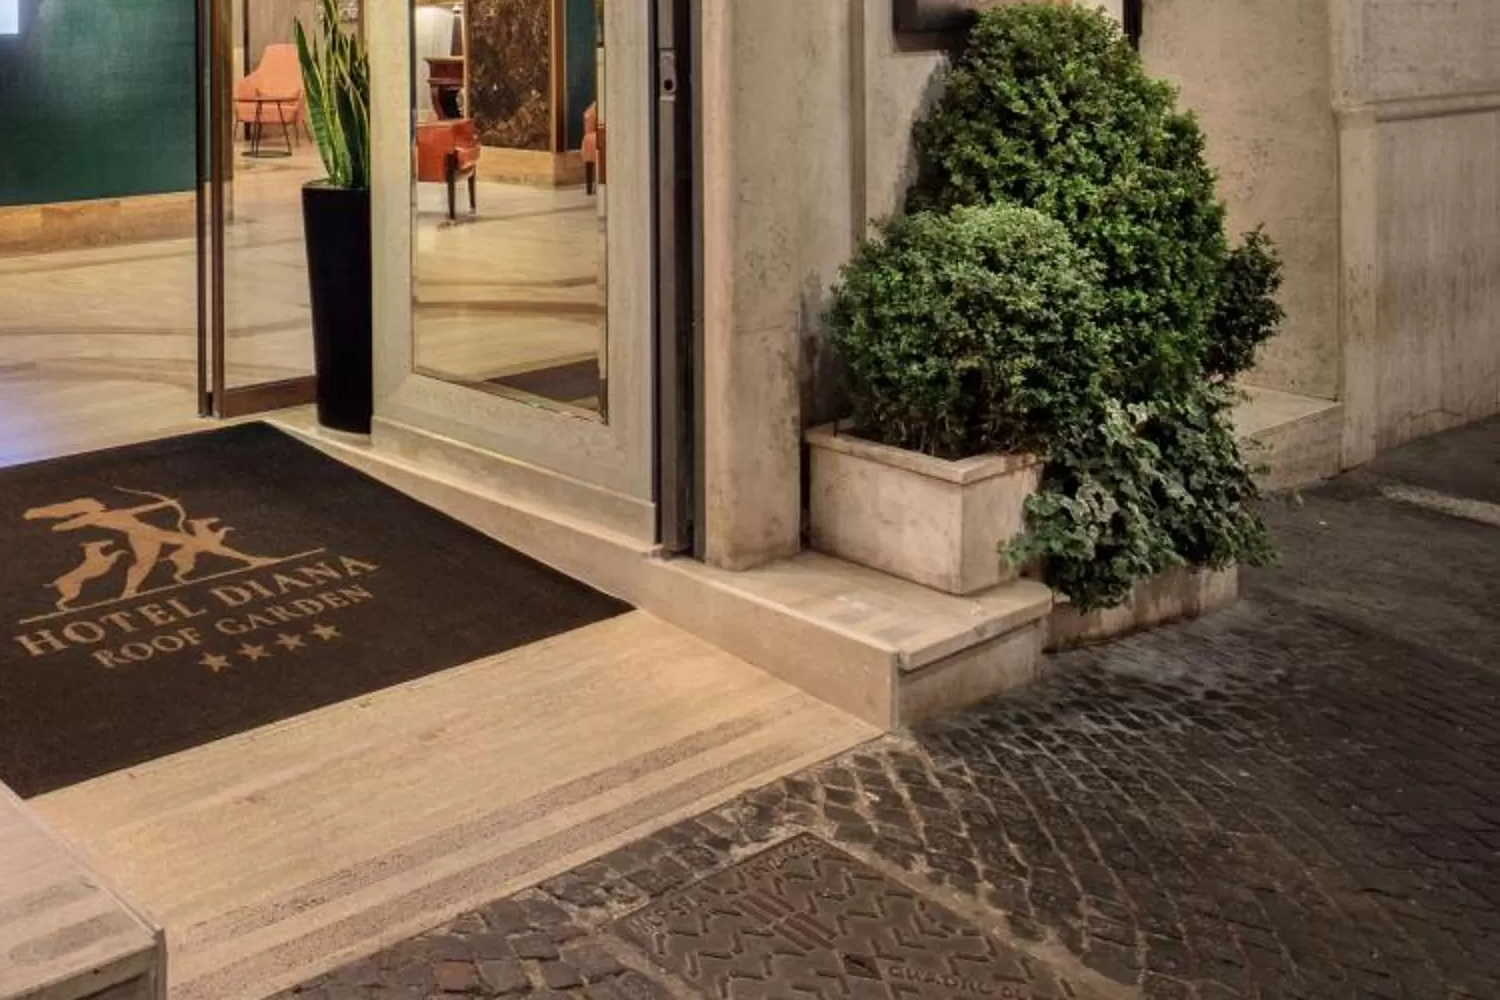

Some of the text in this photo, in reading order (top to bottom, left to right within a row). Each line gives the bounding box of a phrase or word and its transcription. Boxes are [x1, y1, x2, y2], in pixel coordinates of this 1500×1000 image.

[13, 554, 382, 658] HOTEL DIANA
[91, 583, 374, 670] ROOF GARDEN
